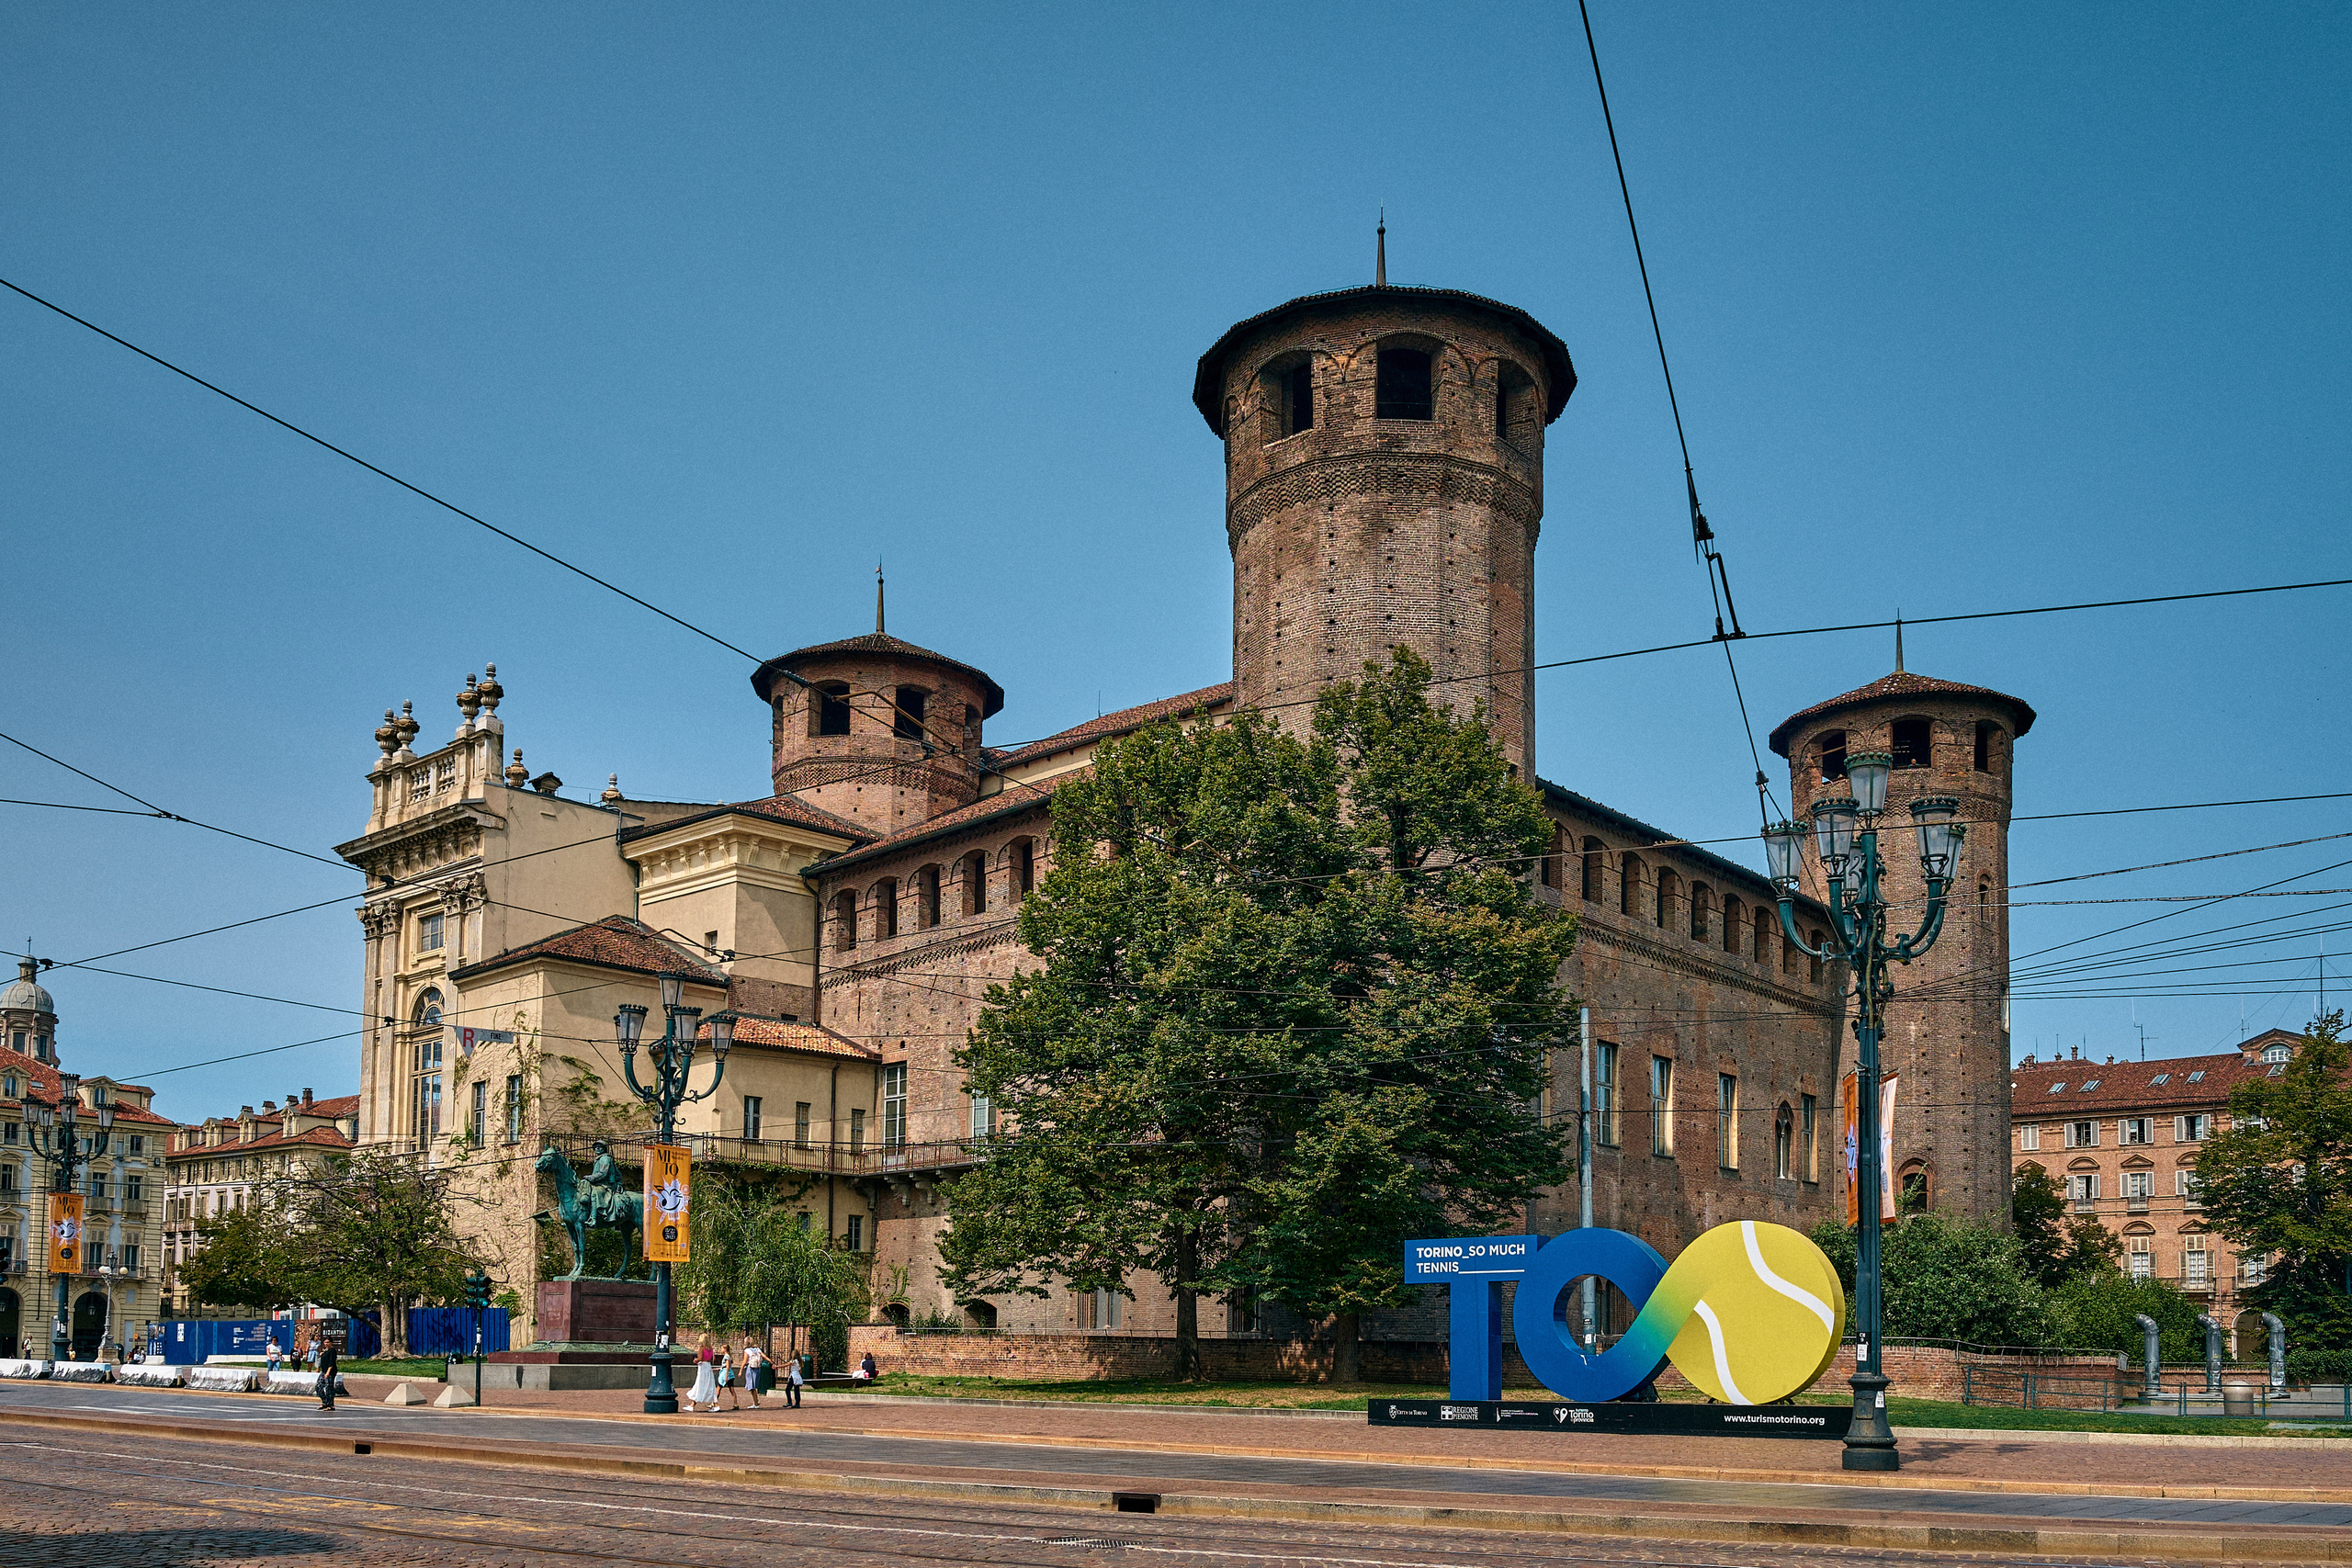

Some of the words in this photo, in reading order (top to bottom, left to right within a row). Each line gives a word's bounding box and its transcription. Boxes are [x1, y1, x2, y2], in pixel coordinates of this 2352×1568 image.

[463, 1028, 474, 1048] R
[657, 1149, 671, 1163] MI
[663, 1162, 679, 1176] TO
[58, 1196, 68, 1205] MI
[1489, 1244, 1525, 1256] MUCH
[1568, 1409, 1594, 1418] Torino
[1724, 1415, 1826, 1426] www.turismotorino.org
